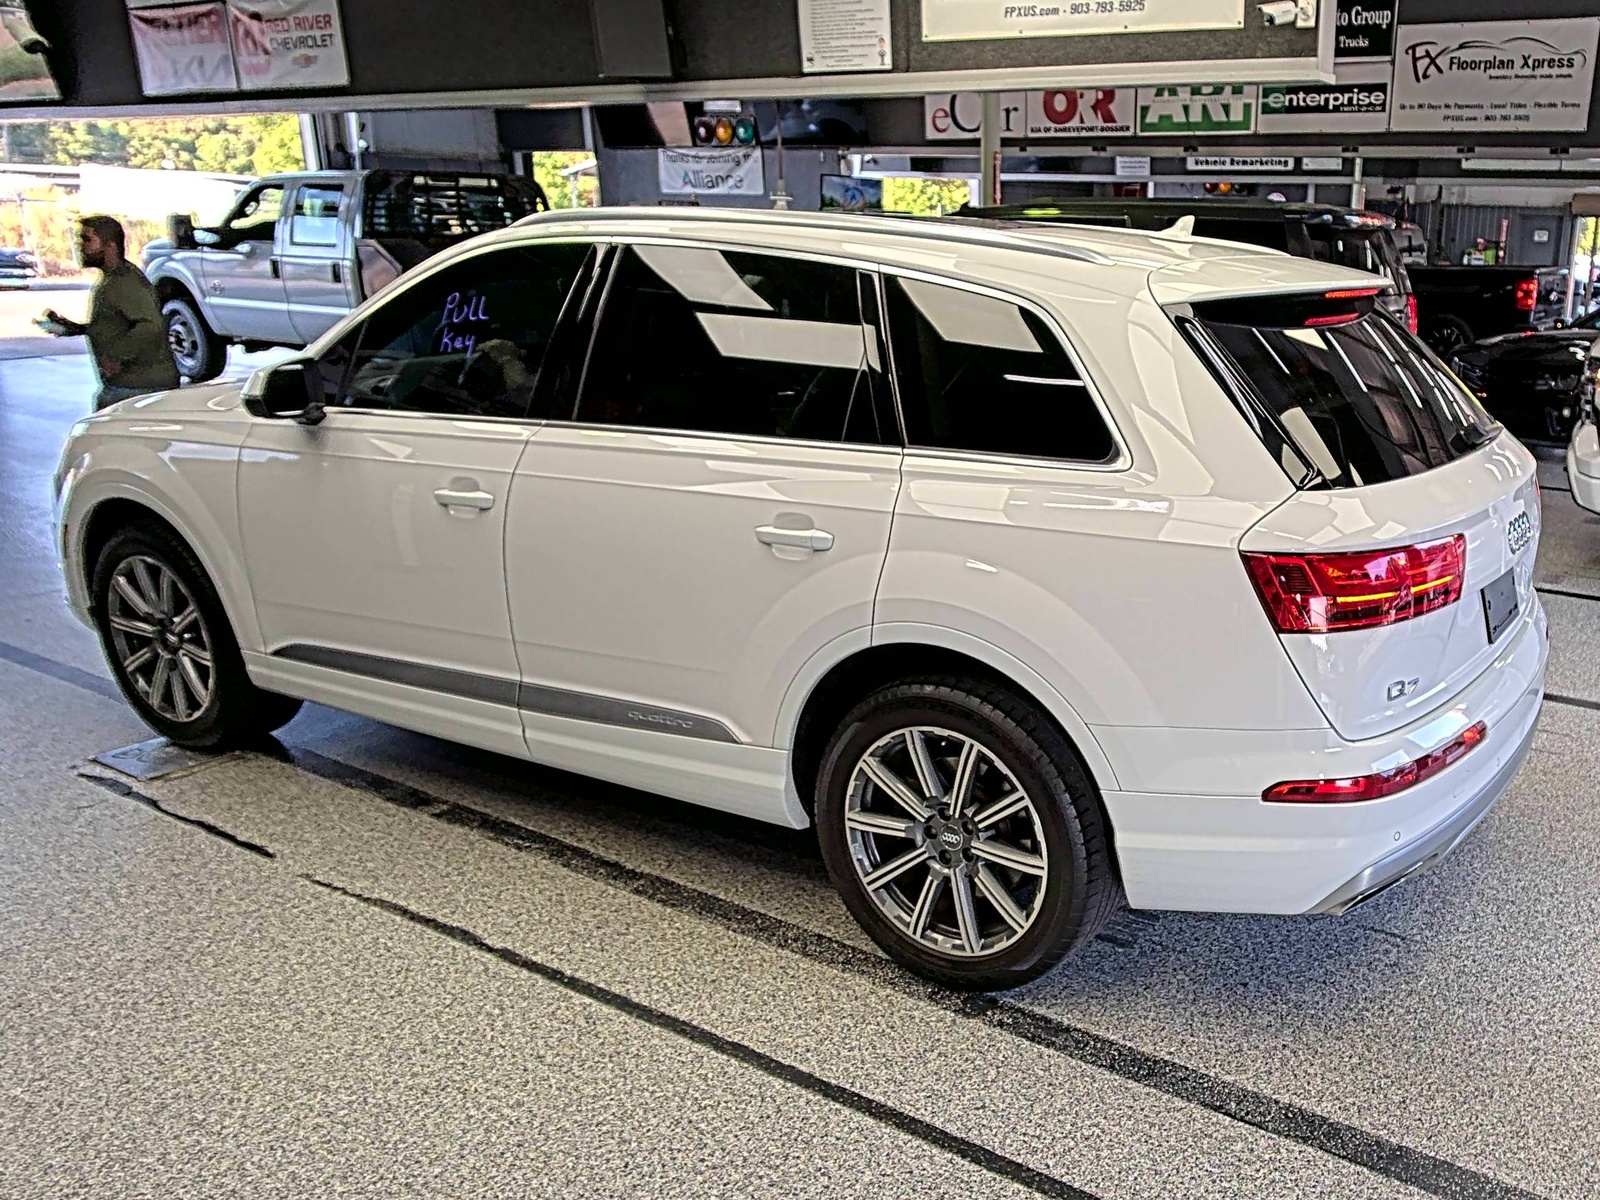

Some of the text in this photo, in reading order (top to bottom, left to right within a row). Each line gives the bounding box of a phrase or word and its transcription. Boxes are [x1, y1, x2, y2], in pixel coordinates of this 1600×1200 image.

[1004, 0, 1146, 18] FPXUS.com 903-793-5925
[1336, 5, 1392, 29] to Group
[293, 14, 332, 31] RIVER
[270, 33, 334, 50] CHEVROLET
[1339, 34, 1370, 48] Trucks
[1449, 54, 1576, 73] Floorplan Xpress
[1262, 88, 1385, 110] enterprise
[931, 93, 1019, 133] eCr
[1194, 158, 1289, 168] Vehicle Remarketing
[682, 170, 744, 189] Alliance
[441, 292, 489, 323] Pull
[1387, 677, 1420, 702] Q7
[628, 711, 693, 728] quattro
